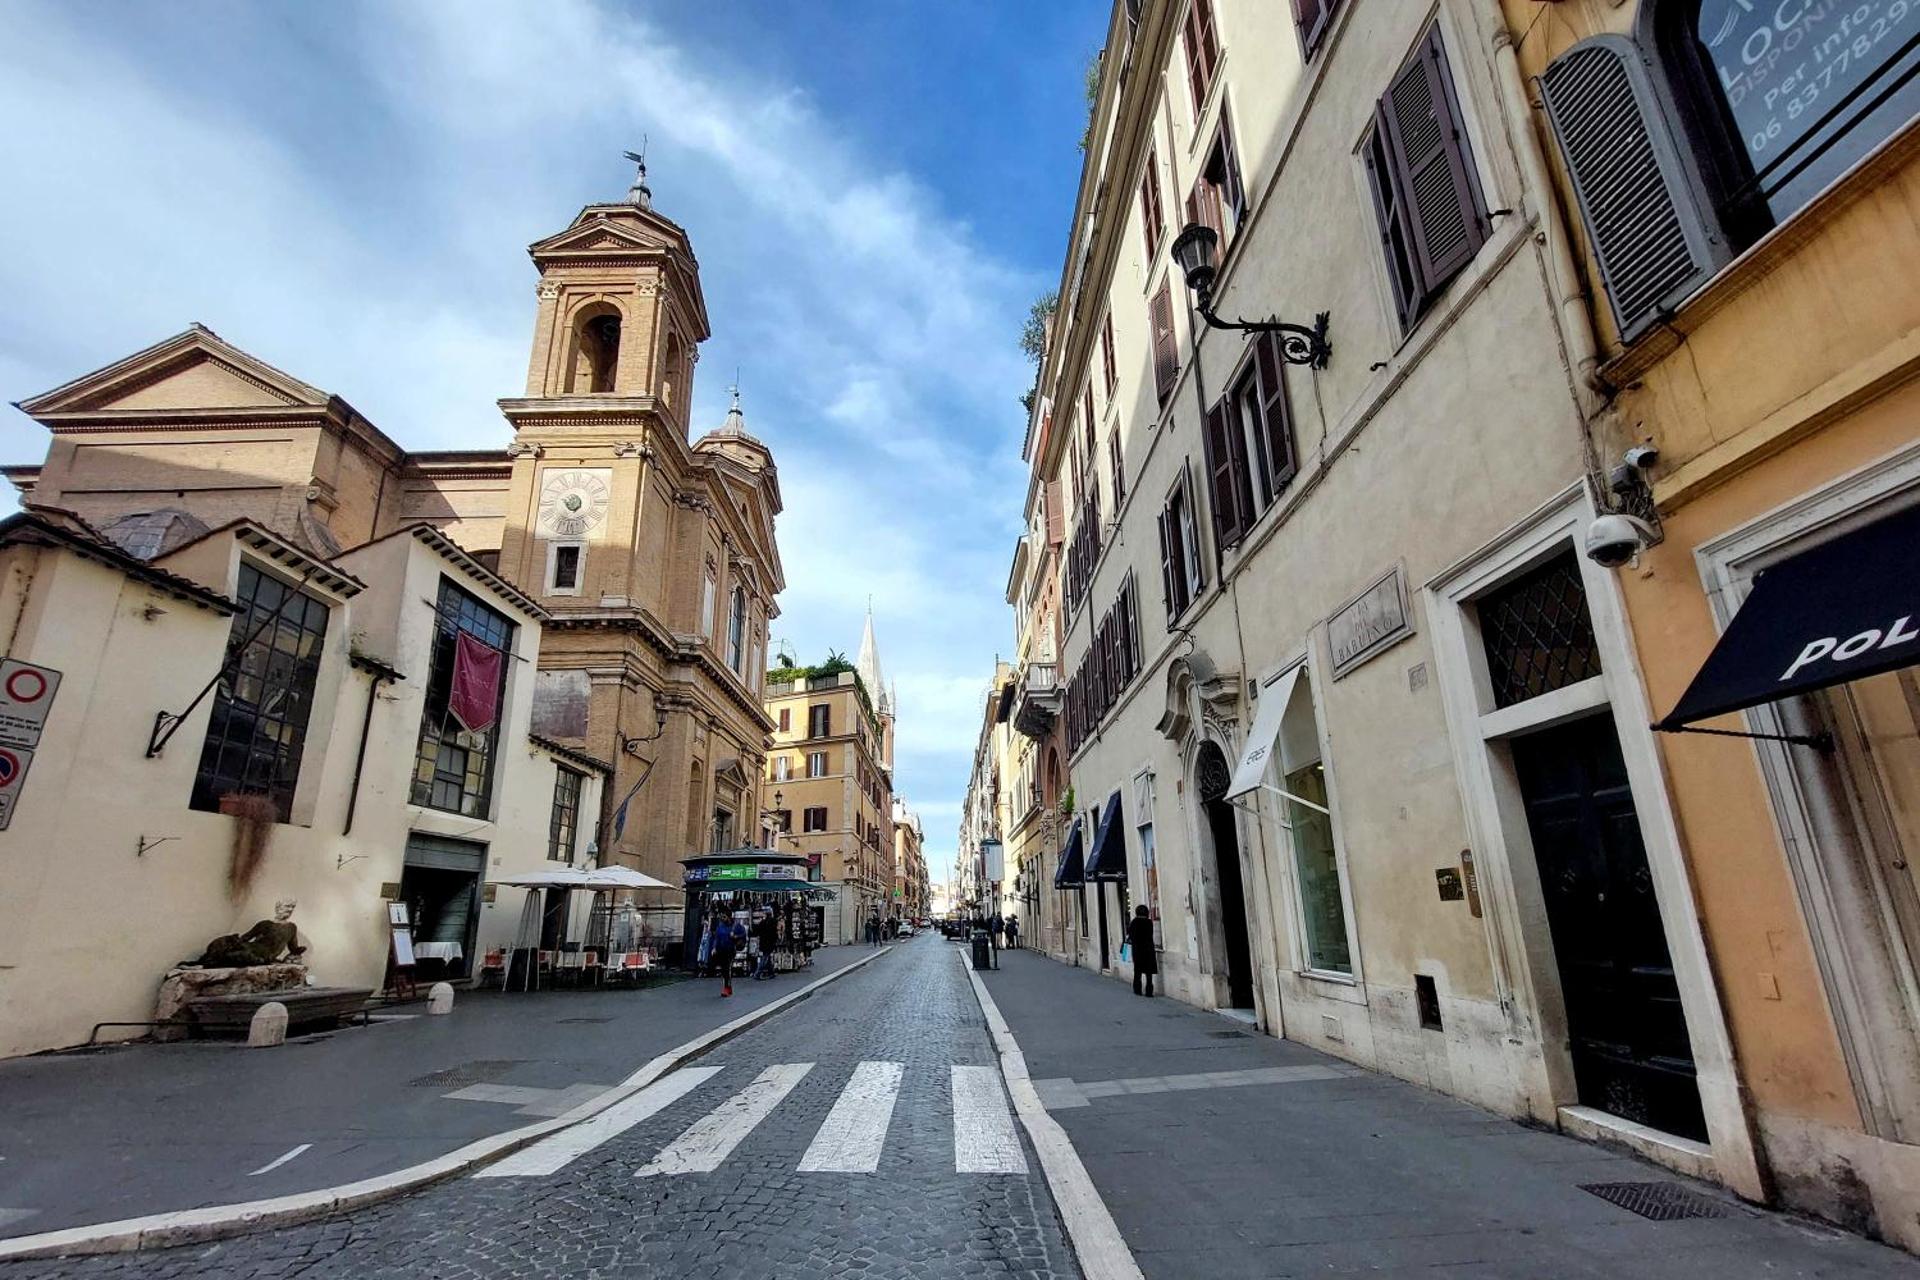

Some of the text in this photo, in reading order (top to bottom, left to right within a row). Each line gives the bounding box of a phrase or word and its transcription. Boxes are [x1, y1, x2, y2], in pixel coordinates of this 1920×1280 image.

[1720, 0, 1813, 90] LOC
[1752, 0, 1920, 151] 06 8377829
[1763, 63, 1806, 110] Per
[713, 891, 734, 901] ATM
